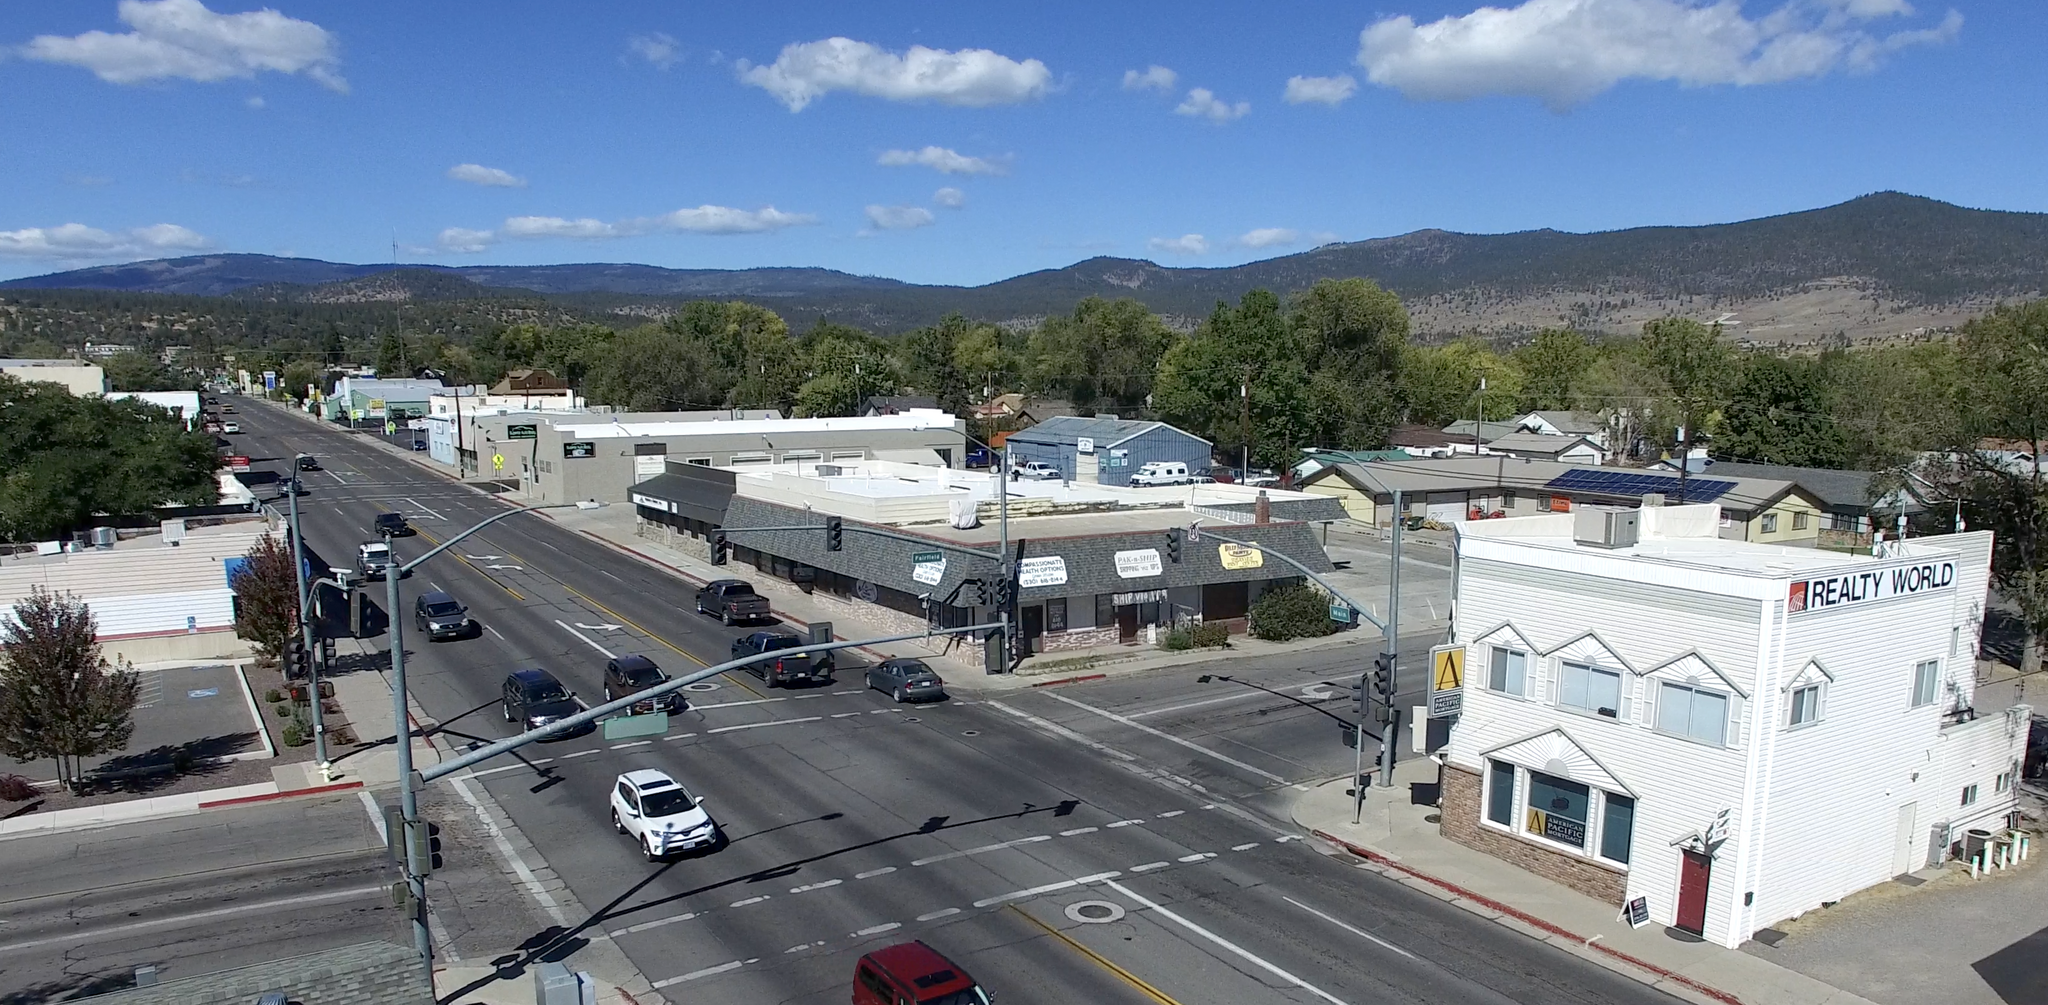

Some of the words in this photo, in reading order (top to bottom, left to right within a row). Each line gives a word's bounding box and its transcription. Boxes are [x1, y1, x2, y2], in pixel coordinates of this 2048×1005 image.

[1040, 565, 1065, 573] OPTIONS
[1811, 571, 1884, 608] REALTY
[1892, 563, 1953, 595] WORLD
[1333, 609, 1347, 618] Main
[1435, 699, 1460, 709] PACIFIC
[1435, 704, 1460, 713] MORTGAGE
[1547, 822, 1584, 839] PACIFIC
[1548, 818, 1584, 832] AMERICAN
[1547, 829, 1582, 844] MORTGAGE
